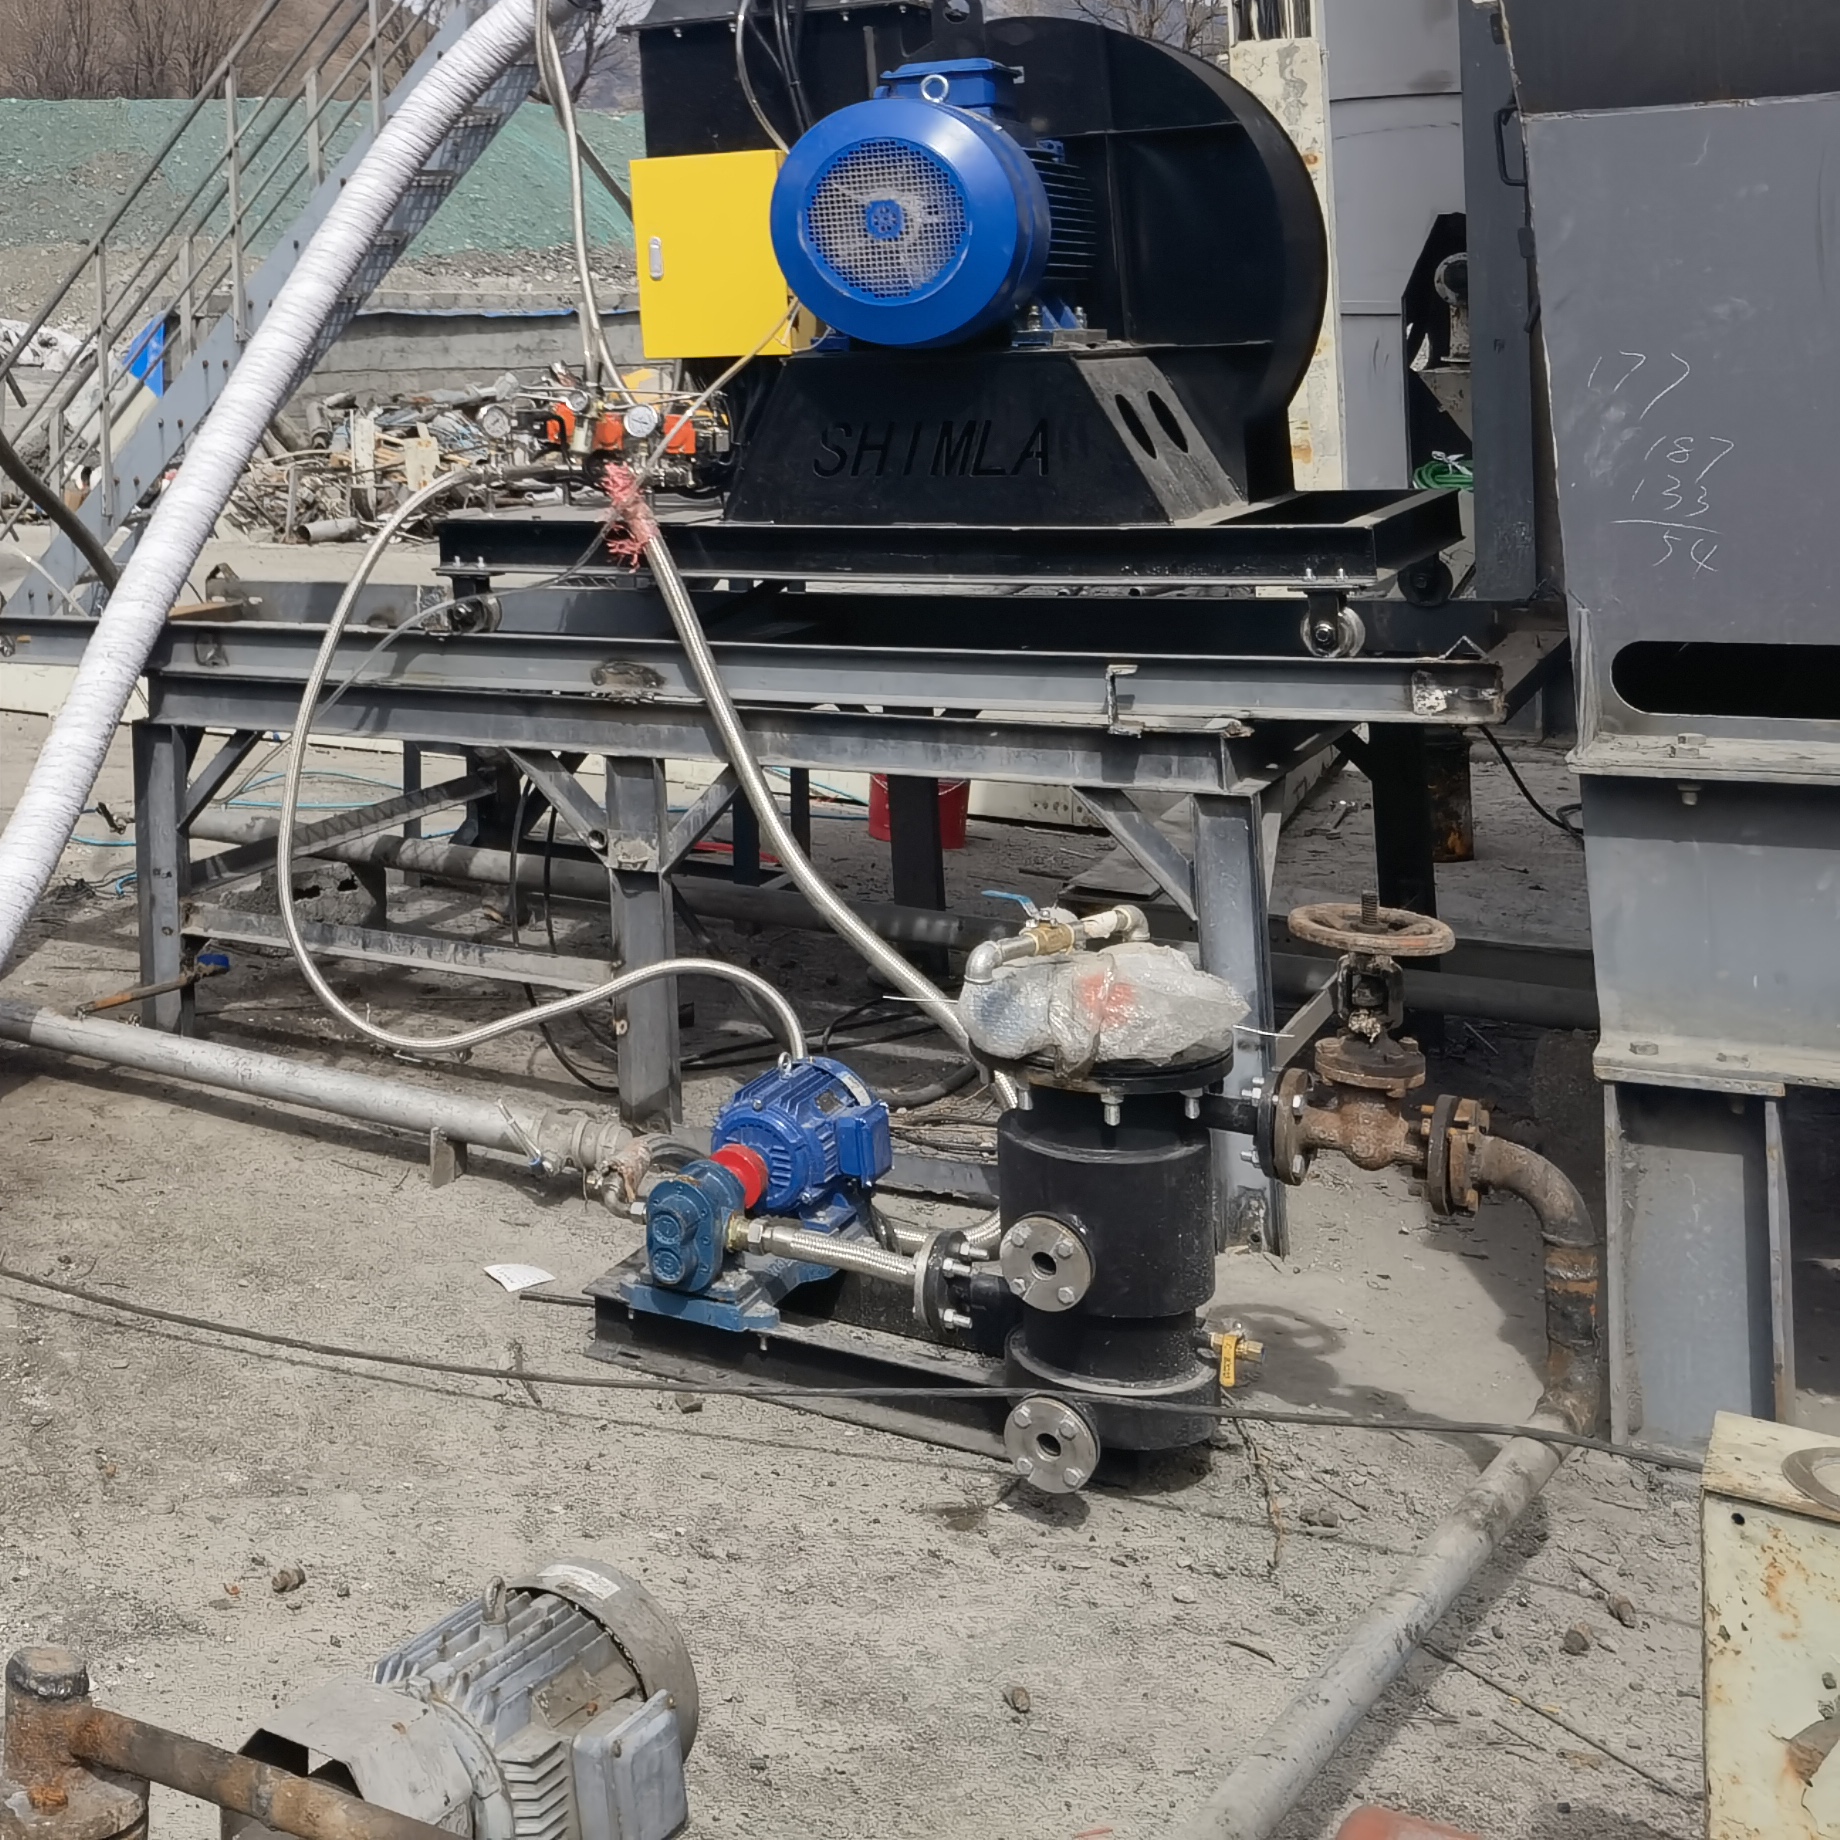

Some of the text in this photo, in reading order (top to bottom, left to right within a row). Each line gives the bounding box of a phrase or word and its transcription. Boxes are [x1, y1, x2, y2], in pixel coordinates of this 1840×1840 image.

[812, 418, 1049, 478] SHIMLA
[1644, 436, 1734, 484] 187
[1631, 475, 1709, 517] 133
[1653, 530, 1718, 578] 54
